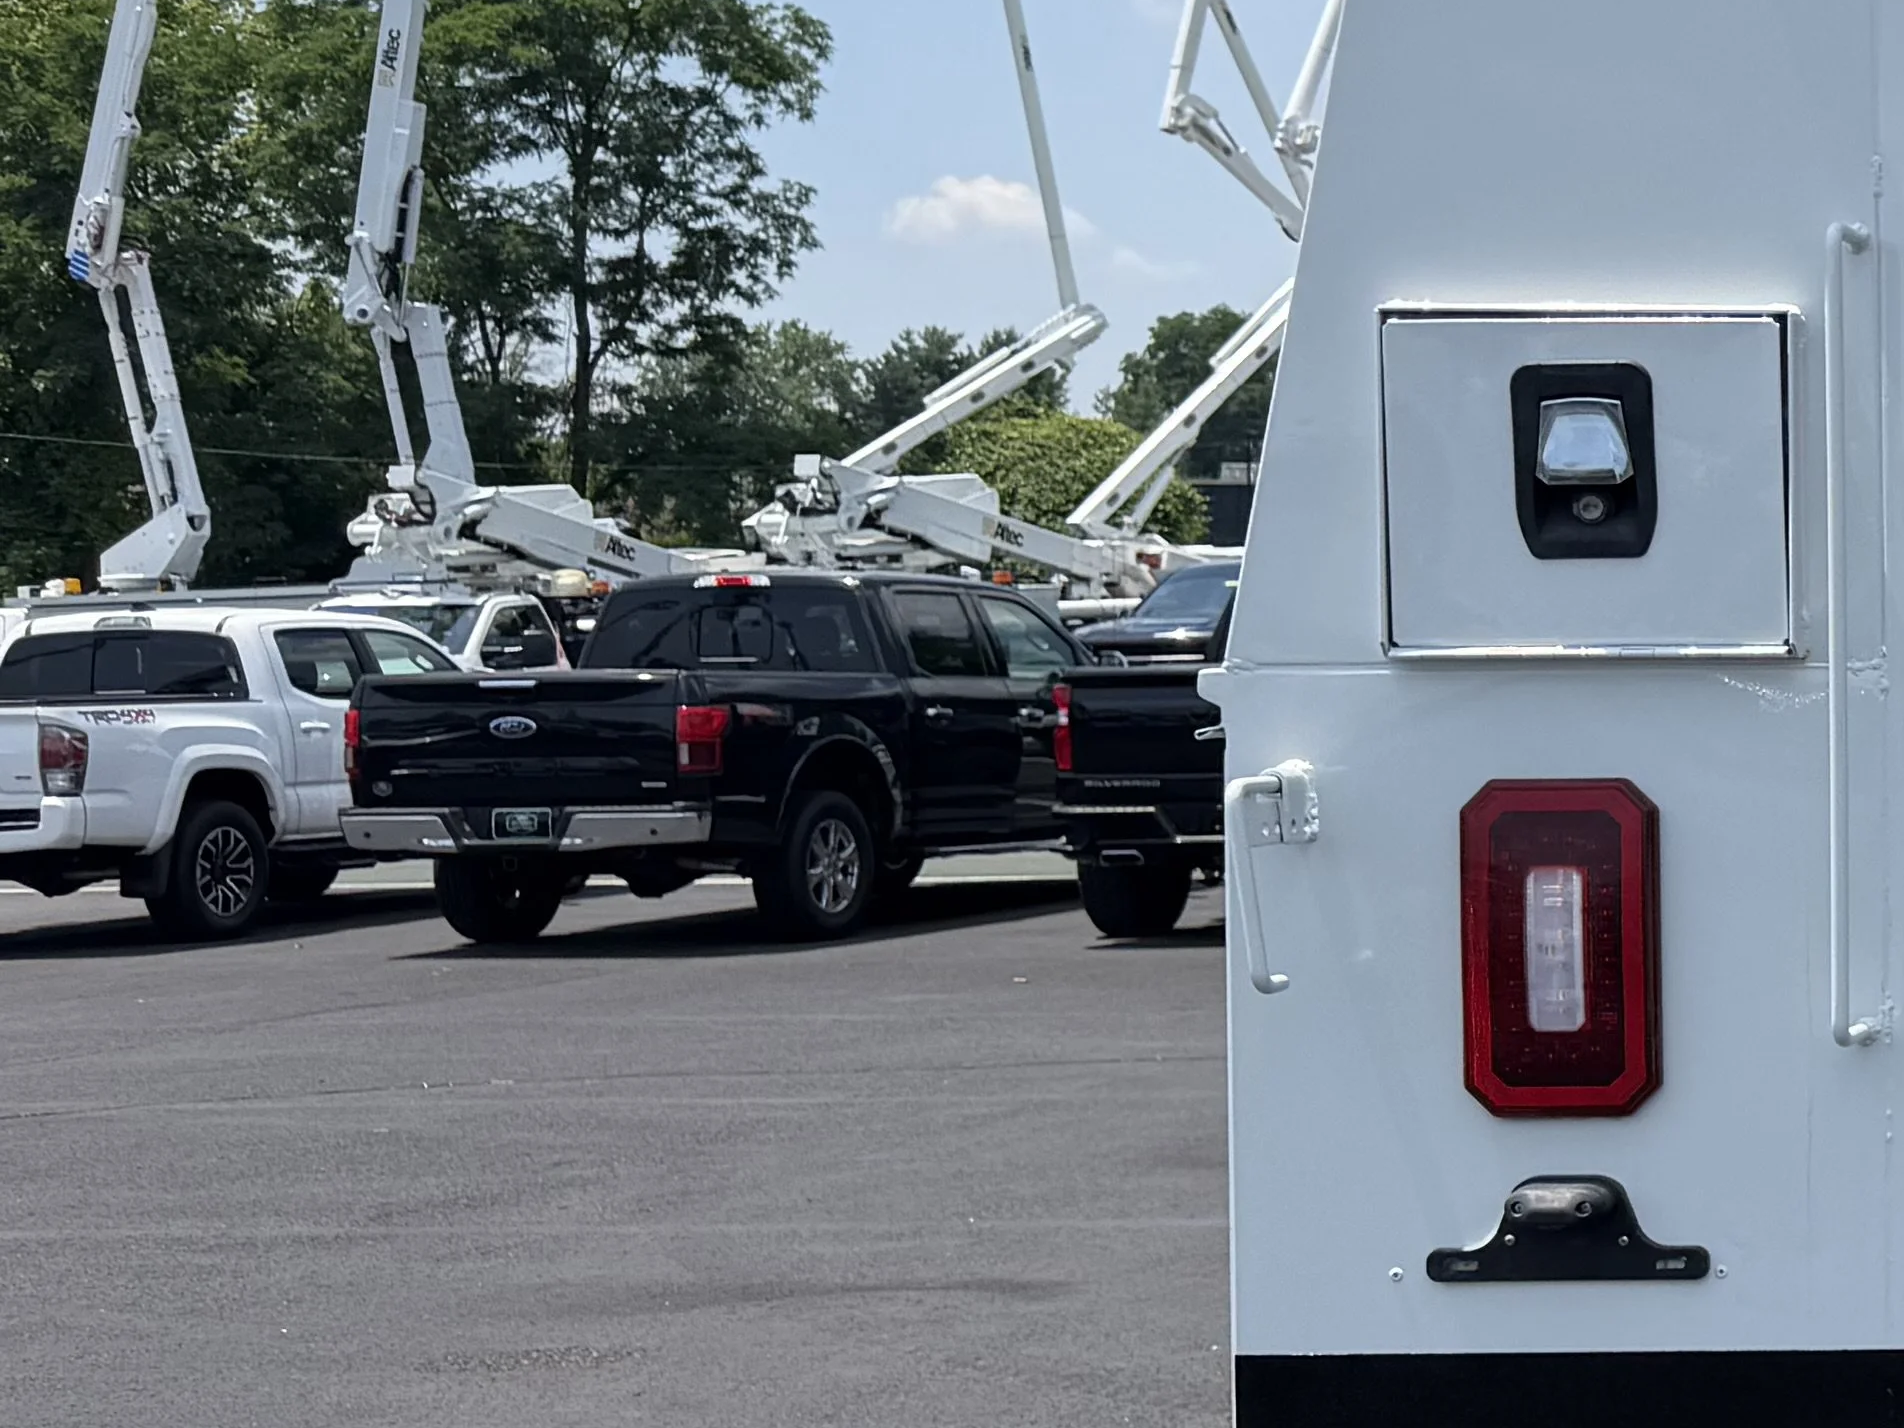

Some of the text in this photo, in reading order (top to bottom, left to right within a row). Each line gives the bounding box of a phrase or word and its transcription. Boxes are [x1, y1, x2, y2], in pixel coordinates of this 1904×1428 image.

[381, 28, 401, 72] Altec
[994, 521, 1024, 548] Altec
[605, 535, 636, 562] Altec
